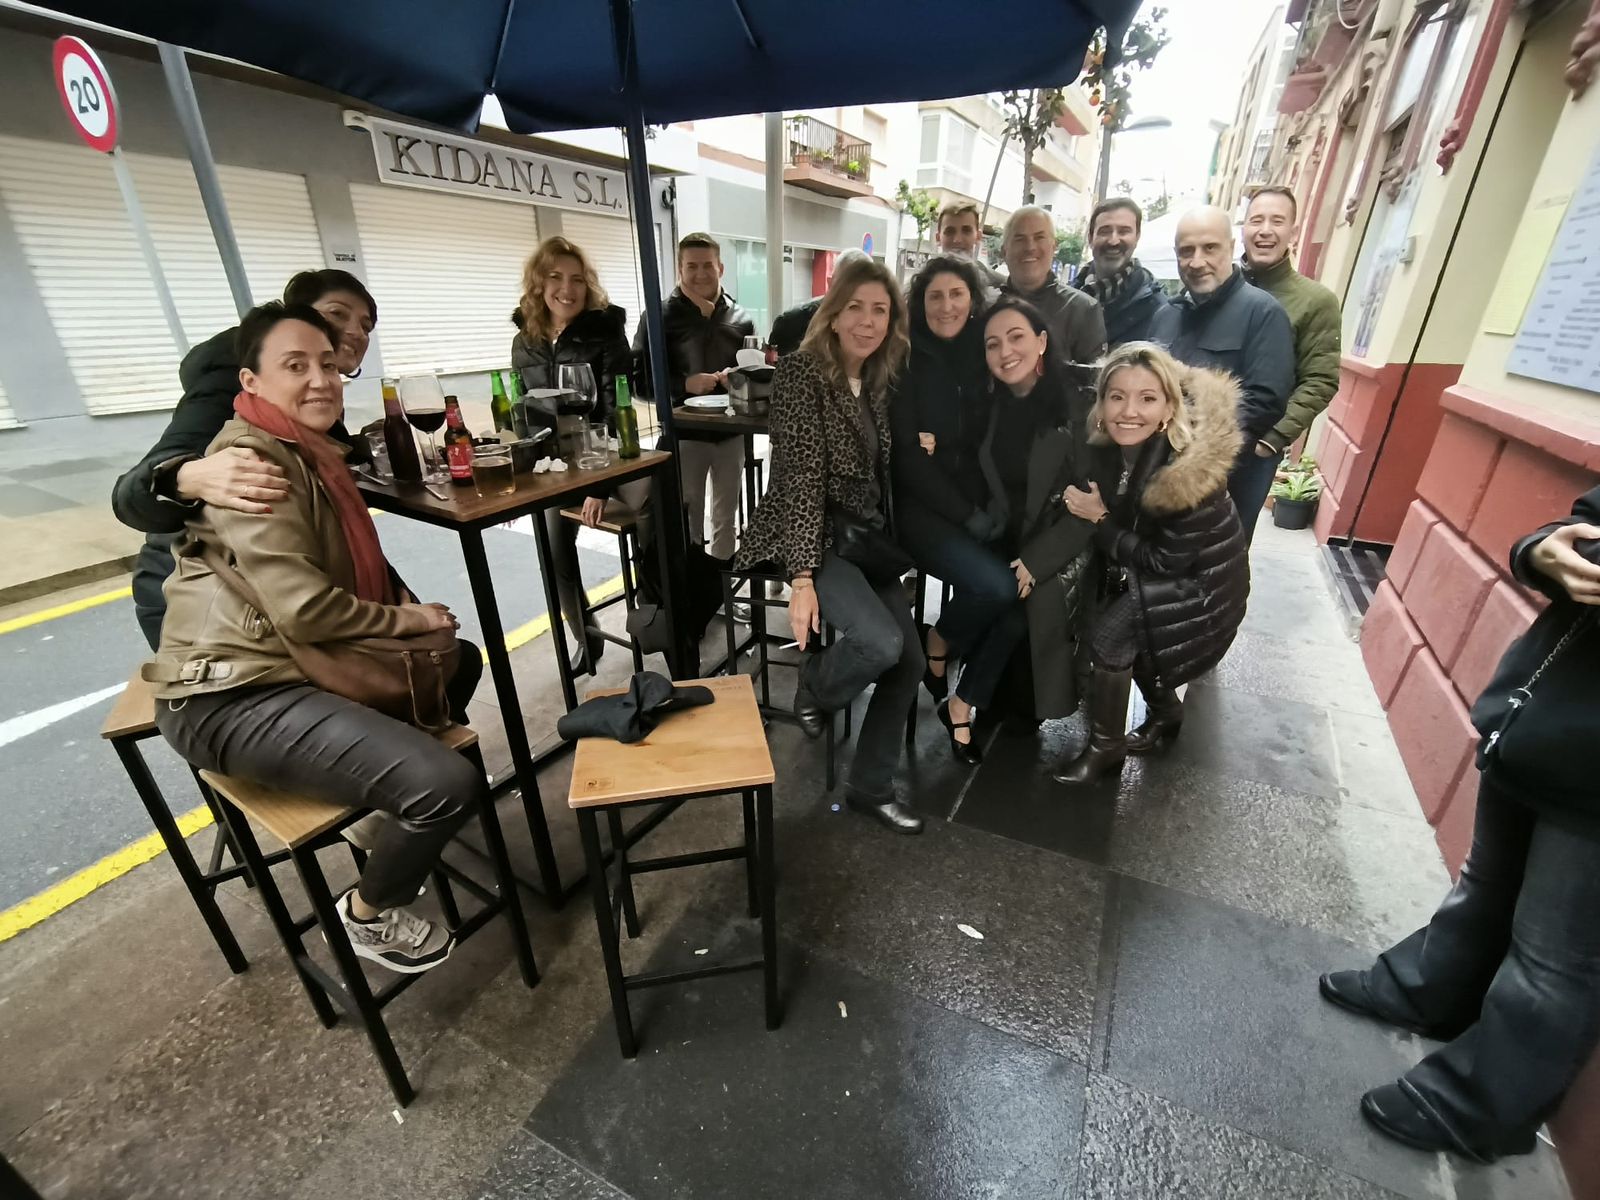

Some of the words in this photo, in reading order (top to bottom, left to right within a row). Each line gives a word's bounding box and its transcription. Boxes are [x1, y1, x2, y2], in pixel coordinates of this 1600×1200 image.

[70, 76, 100, 114] 20
[383, 131, 562, 199] KIDANA
[572, 171, 623, 210] S.L.
